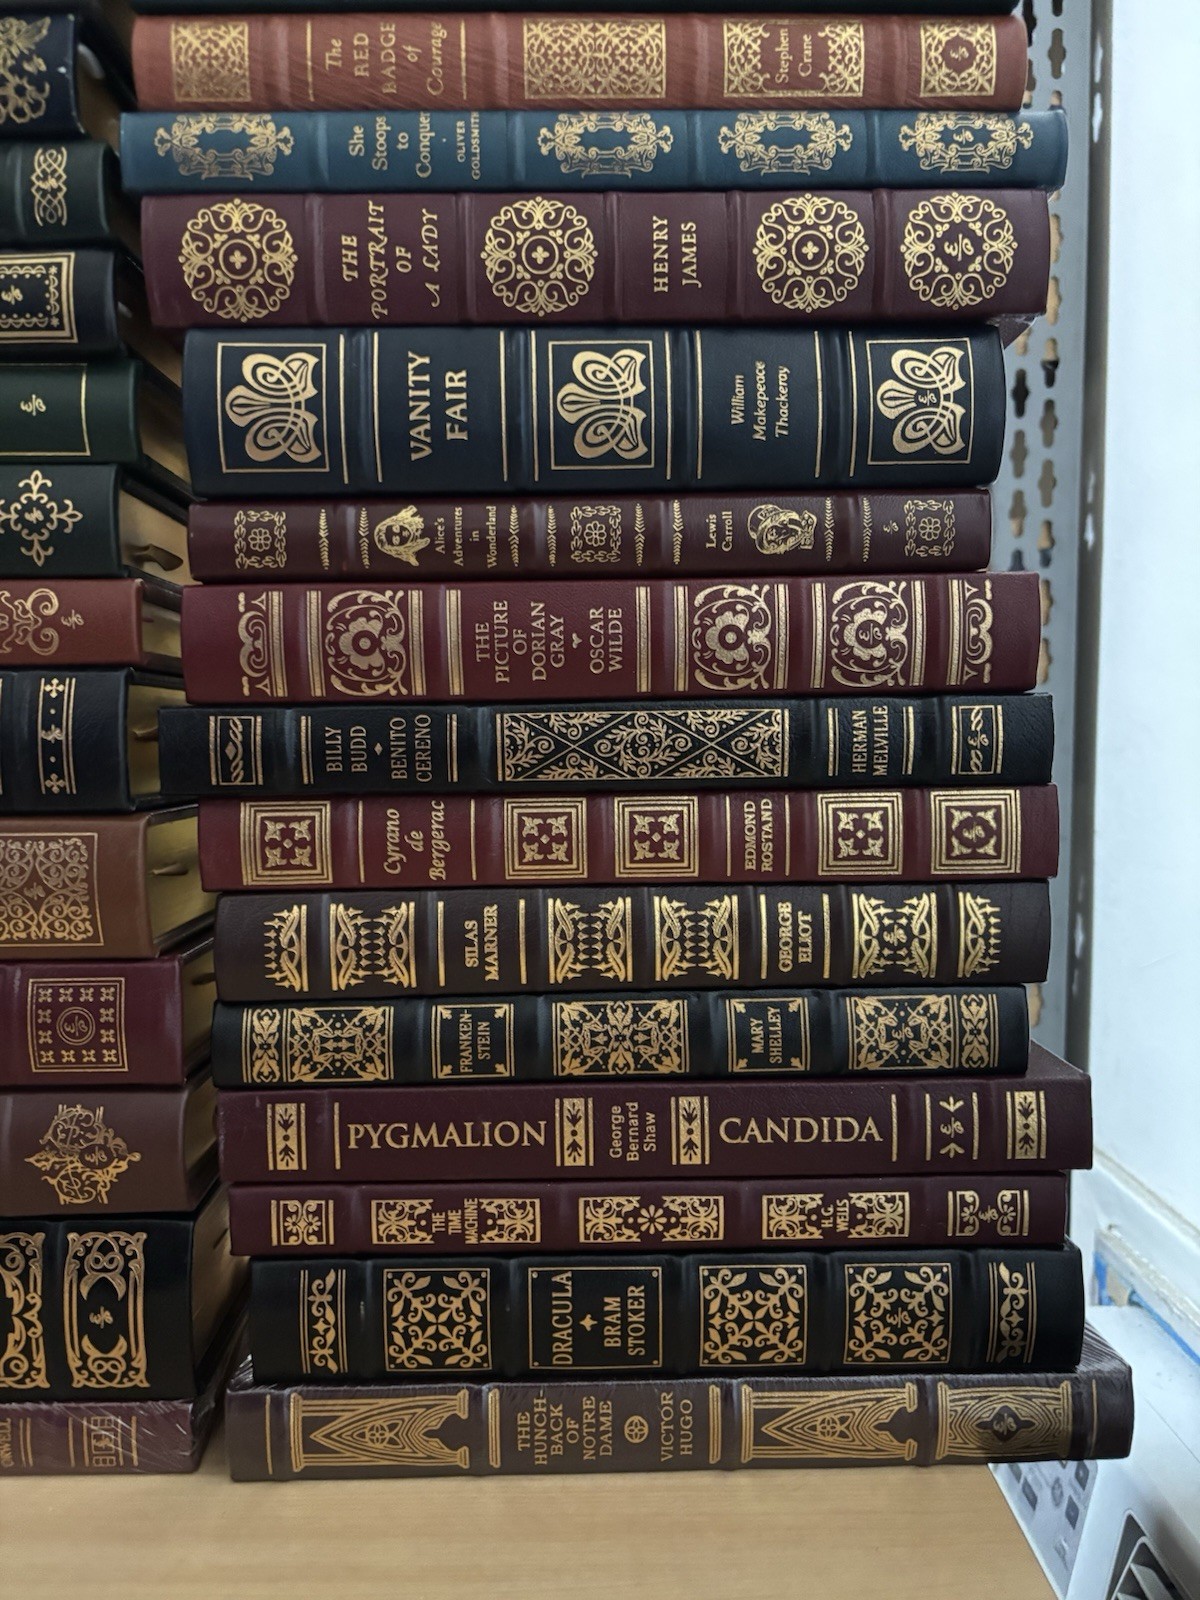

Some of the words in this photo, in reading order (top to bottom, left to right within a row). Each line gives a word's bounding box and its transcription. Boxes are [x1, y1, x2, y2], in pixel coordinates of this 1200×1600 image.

[325, 38, 342, 71] The
[353, 32, 369, 77] RED
[380, 22, 397, 94] BADGE
[403, 44, 422, 63] of
[426, 21, 447, 96] Courage
[775, 28, 793, 83] Stephen
[798, 34, 812, 77] Crane
[349, 125, 364, 157] She
[372, 115, 391, 171] Stoops
[396, 132, 409, 150] to
[456, 120, 466, 163] OLIVER
[341, 234, 358, 282] THE
[367, 200, 389, 320] PORTRAIT
[395, 246, 412, 273] OF
[421, 208, 441, 272] LADY
[653, 215, 668, 293] HENRY
[681, 222, 702, 288] JAMES
[425, 282, 441, 307] A
[408, 351, 432, 461] VANITY
[445, 369, 469, 441] FAIR
[731, 374, 745, 425] William
[752, 361, 770, 441] Makepeace
[775, 365, 791, 438] Thackeray
[434, 517, 445, 554] Alice's
[453, 507, 464, 567] Adventures
[469, 530, 480, 542] in
[485, 505, 498, 569] Wonderland
[706, 513, 717, 548] Lewis
[721, 511, 733, 552] Carroll
[475, 622, 491, 662] THE
[493, 600, 510, 683] PICTURE
[512, 628, 528, 656] OF
[530, 601, 547, 681] DORIAN
[550, 614, 565, 668] GRAY
[589, 606, 605, 675] OSCAR
[608, 607, 623, 673] WILDE
[325, 726, 343, 772] BILLY
[350, 725, 368, 772] BUDD
[389, 717, 408, 780] BENITO
[414, 714, 432, 783] CERENO
[851, 710, 868, 773] HERMAN
[872, 705, 889, 776] MELVILLE
[383, 808, 407, 875] Cyrano
[404, 830, 424, 852] de
[428, 800, 451, 880] Bergerac
[743, 800, 756, 871] EDMOND
[760, 798, 773, 872] ROSTAND
[464, 920, 479, 968] SILAS
[483, 903, 500, 981] MARNER
[777, 901, 793, 973] GEORGE
[798, 910, 813, 964] ELIOT
[459, 1008, 474, 1073] FRANKEN-
[477, 1021, 491, 1060] STEIN
[750, 1017, 764, 1054] MARY
[767, 1006, 782, 1064] SHELLEY
[347, 1120, 547, 1150] PYGMALION
[609, 1105, 625, 1158] George
[625, 1101, 640, 1162] Bernard
[643, 1112, 656, 1152] Shaw
[719, 1116, 883, 1144] CANDIDA
[432, 1211, 446, 1233] THE
[448, 1209, 462, 1235] TIME
[464, 1198, 479, 1245] MACHINE
[836, 1199, 850, 1232] WELLS
[551, 1271, 573, 1365] DRACULA
[603, 1296, 621, 1347] BRAM
[627, 1285, 646, 1356] STOKER
[517, 1411, 531, 1451] THE
[550, 1403, 564, 1456] BACK
[566, 1417, 580, 1444] OF
[583, 1395, 596, 1461] NOTRE
[599, 1400, 613, 1456] DAME
[660, 1391, 674, 1462] VICTOR
[680, 1399, 693, 1456] HUGO
